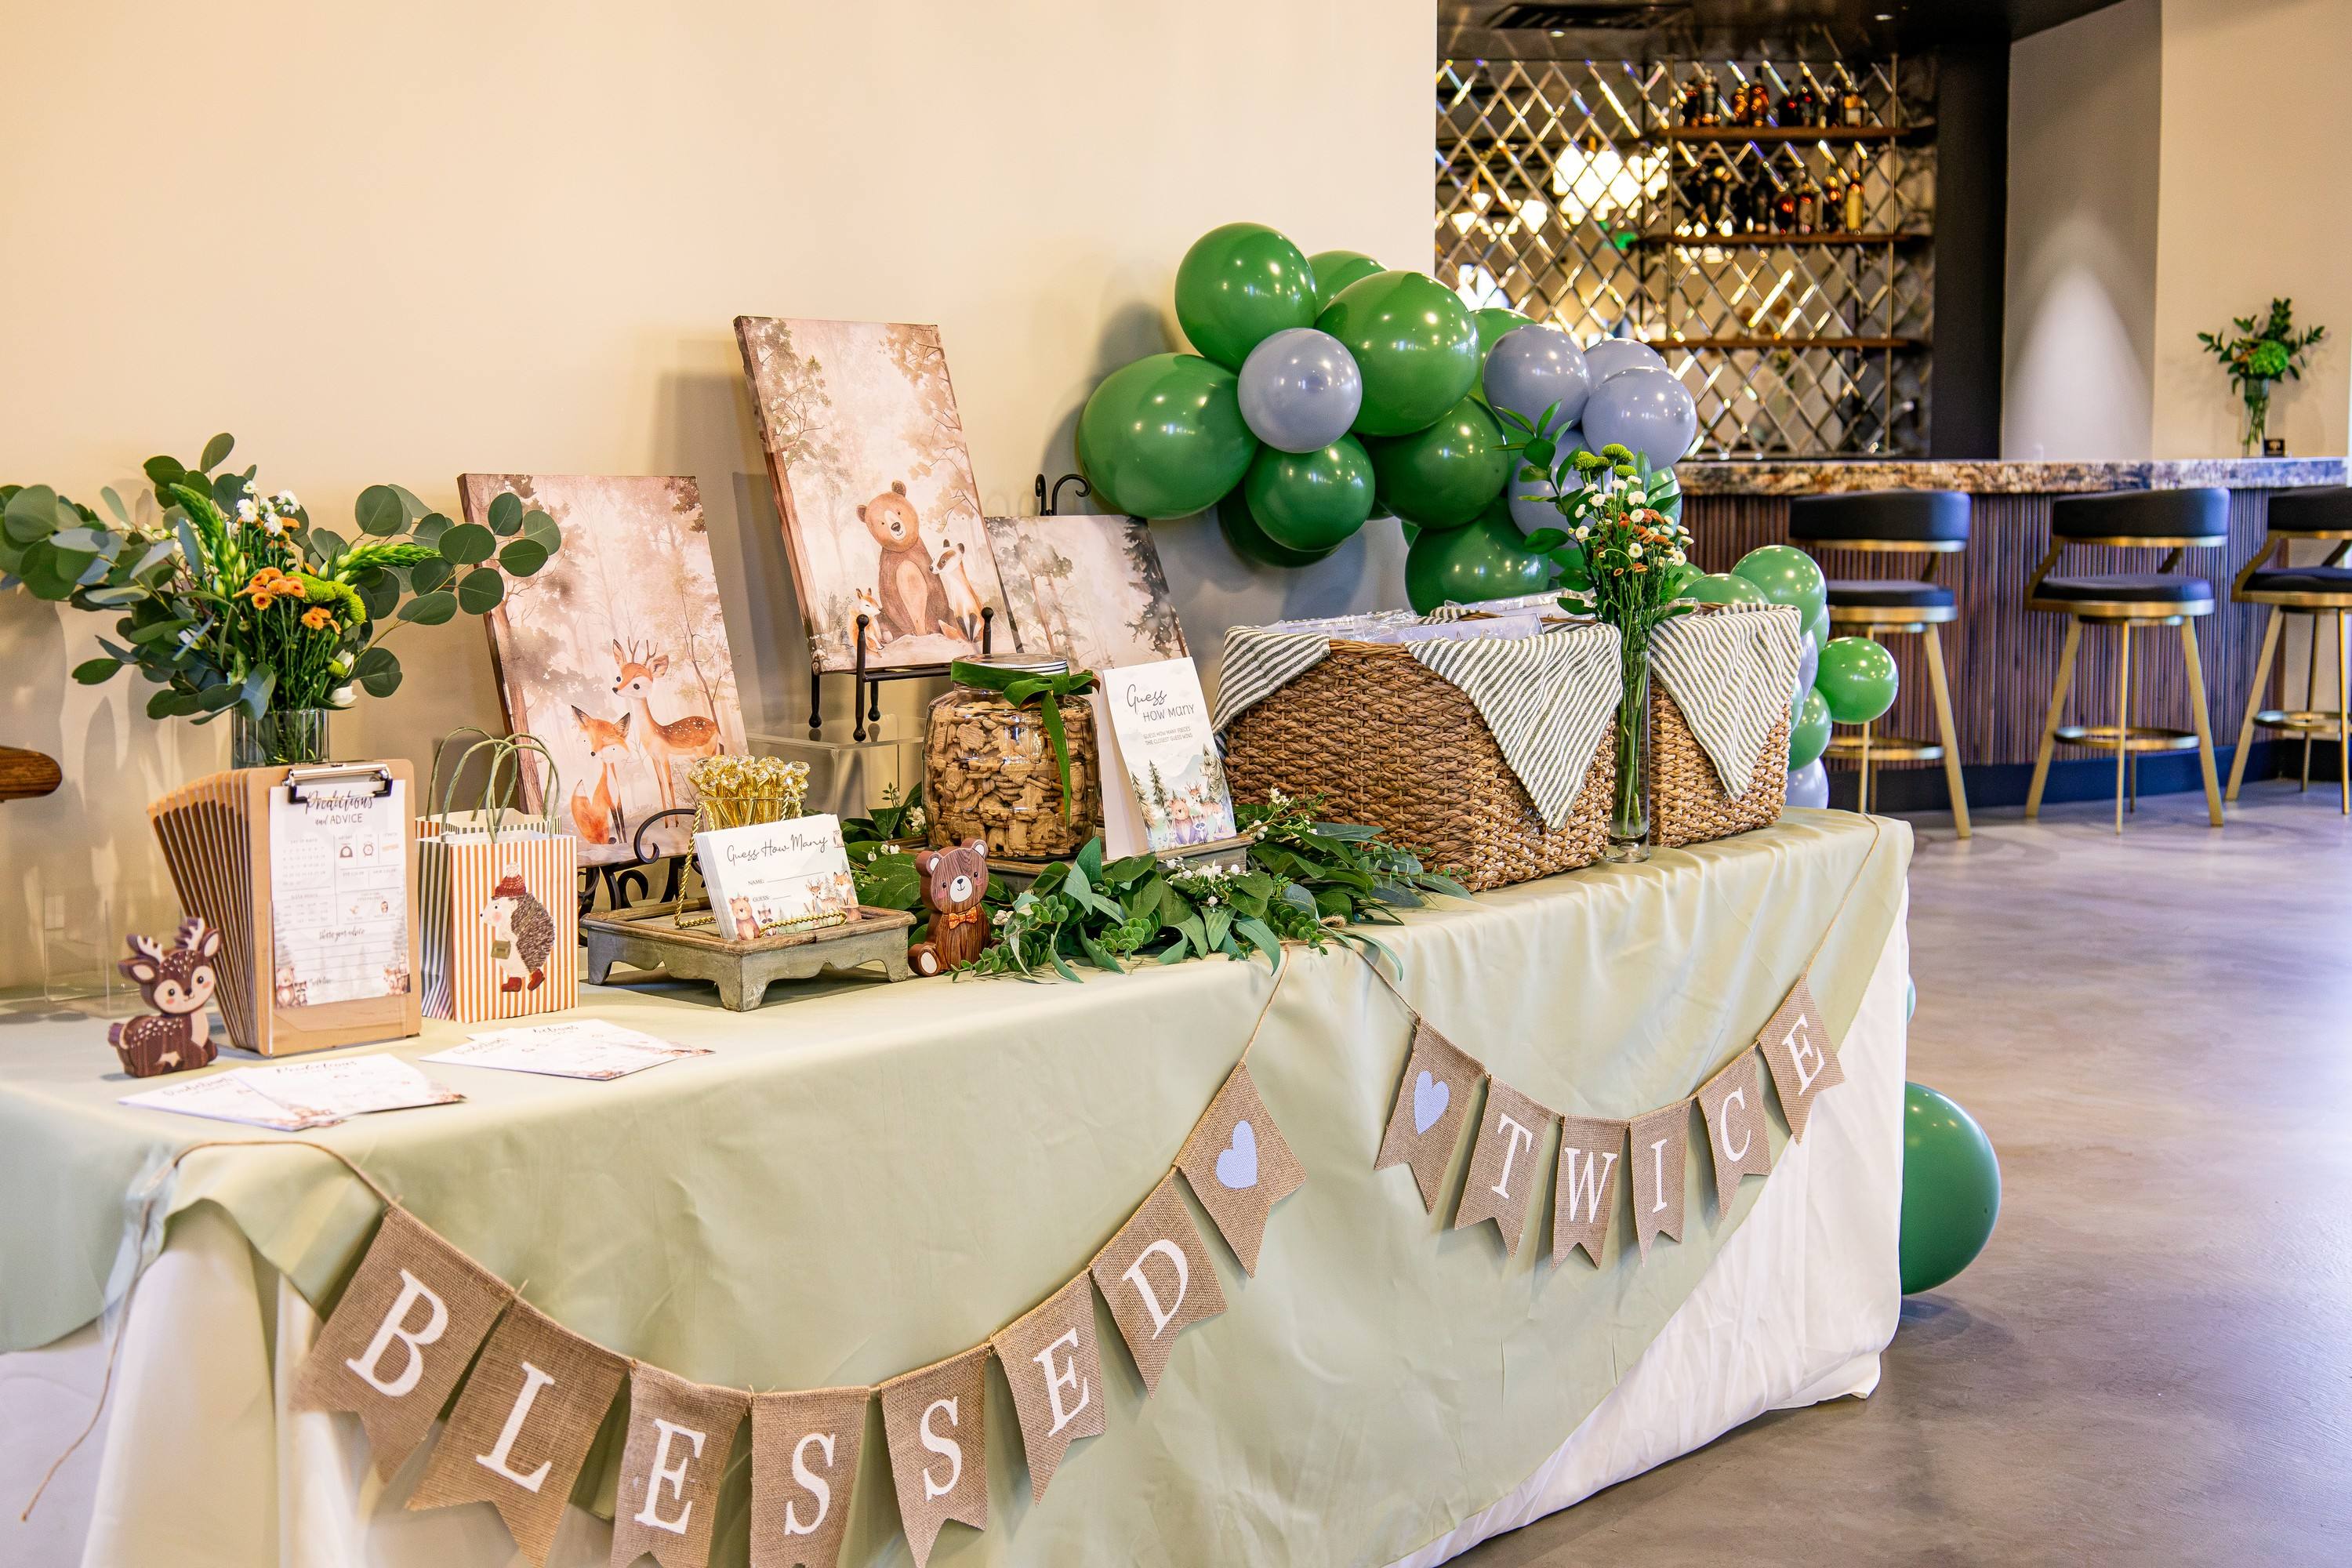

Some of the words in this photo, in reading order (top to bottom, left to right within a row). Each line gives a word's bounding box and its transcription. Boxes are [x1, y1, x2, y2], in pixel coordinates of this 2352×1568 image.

[1127, 684, 1167, 713] Guess
[1142, 710, 1166, 722] HOW
[305, 789, 373, 815] Predictions
[315, 815, 328, 826] and
[330, 813, 364, 825] ADVICE
[727, 844, 760, 866] Guess
[760, 839, 789, 857] How
[789, 833, 828, 854] Many
[1492, 1014, 1824, 1223] TWICE
[346, 1239, 1189, 1536] BLESSED
